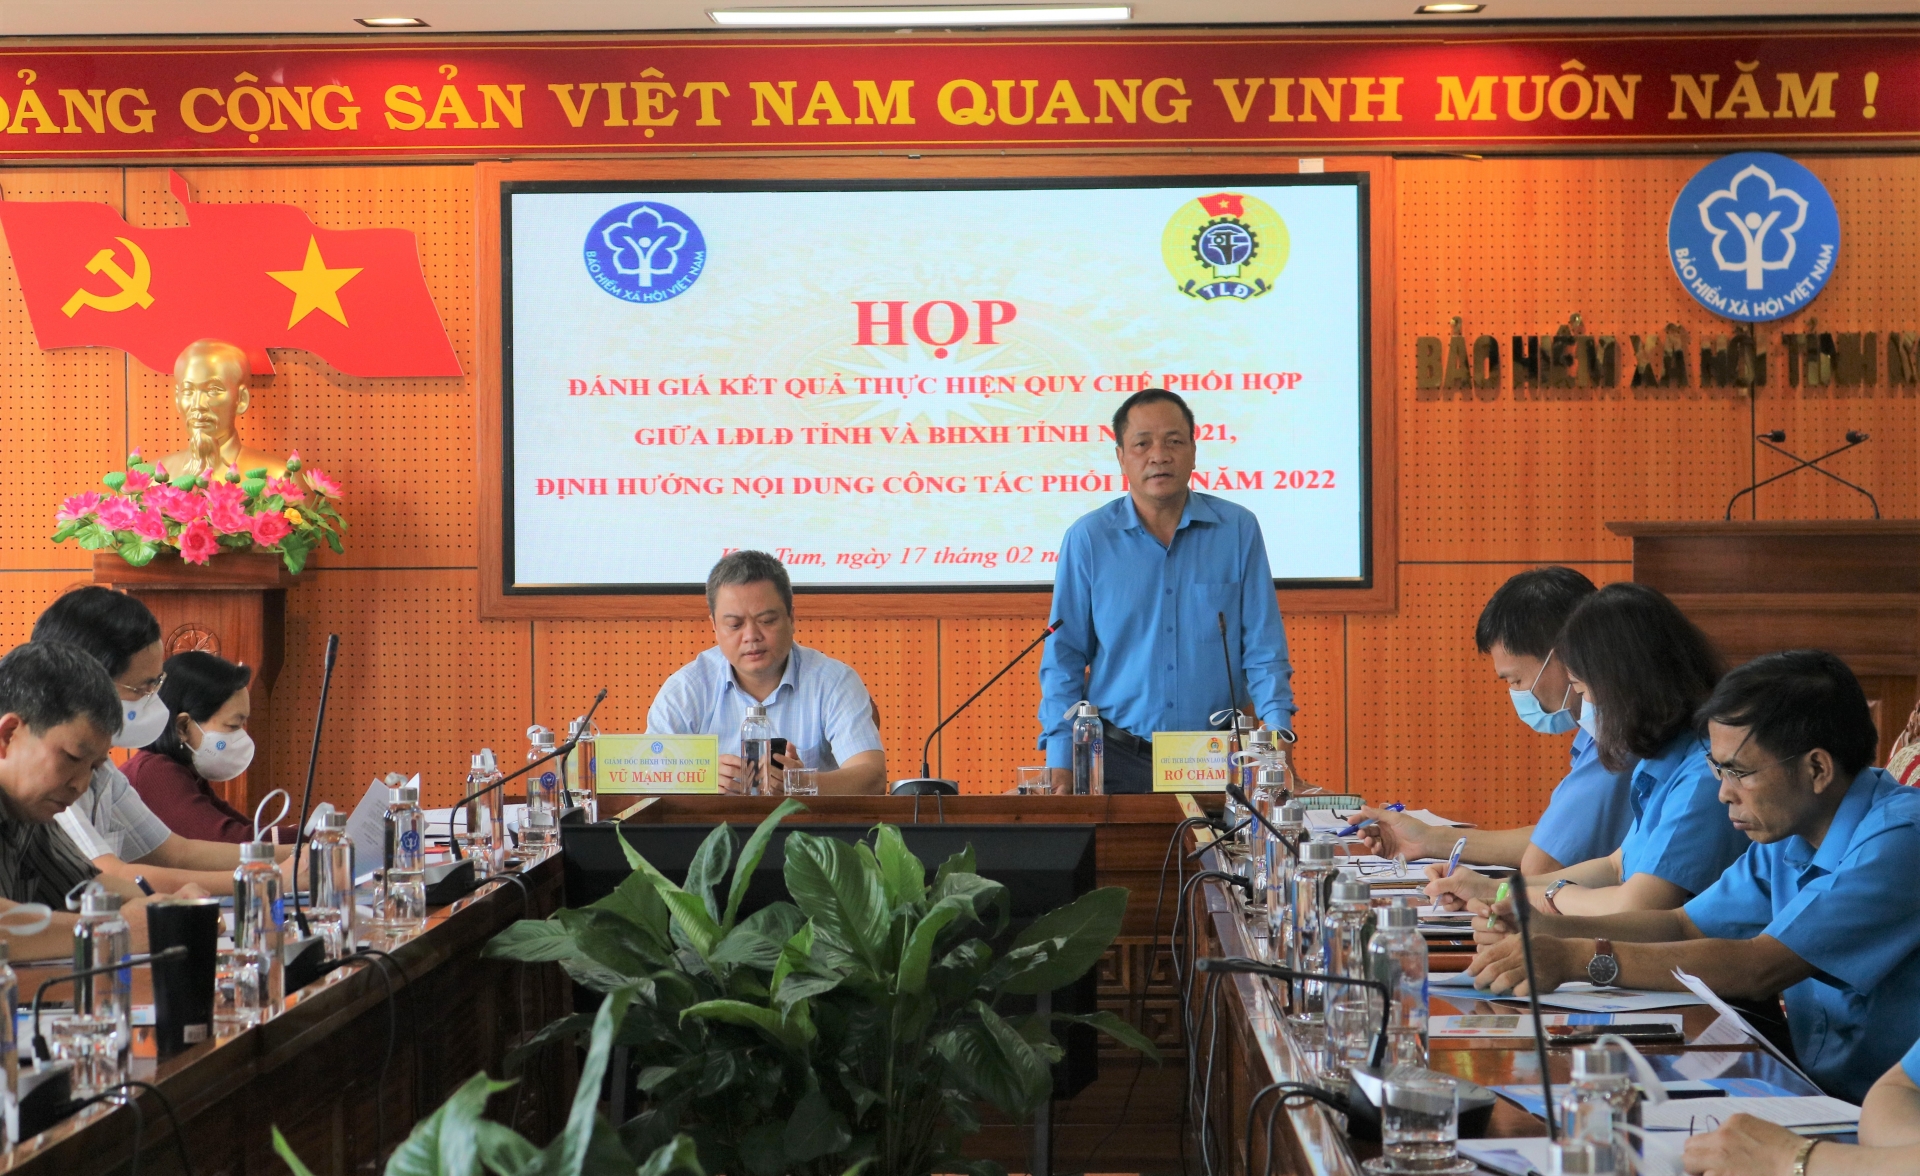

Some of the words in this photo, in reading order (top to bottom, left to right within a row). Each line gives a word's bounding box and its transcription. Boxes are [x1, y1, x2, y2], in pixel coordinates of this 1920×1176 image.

[0, 69, 156, 134] ẢNG
[180, 71, 360, 143] CỘNG
[383, 65, 526, 131] SẢN
[549, 68, 730, 138] VIỆT
[750, 80, 916, 126] NAM
[936, 78, 1192, 126] QUANG
[1214, 76, 1404, 124] VINH
[1435, 59, 1641, 122] MUÔN
[1669, 60, 1839, 119] NĂM
[688, 251, 705, 276] NAM
[1203, 283, 1249, 298] TLĐ
[1674, 247, 1698, 280] BẢO
[1691, 278, 1727, 310] HIỂM
[1728, 299, 1750, 316] XÃ
[1754, 297, 1784, 317] HỘI
[1783, 278, 1815, 306] VIỆT
[1810, 244, 1834, 281] NAM
[851, 300, 1017, 359] HỌP
[567, 374, 650, 396] ĐÁNH
[658, 374, 711, 396] GIÁ
[718, 374, 778, 396] KẾT
[784, 373, 848, 399] QUẢ
[854, 374, 937, 399] THỰC
[945, 374, 1016, 398] HIỆN
[1024, 376, 1087, 397] QUY
[1093, 371, 1153, 392] CHẾ
[1162, 370, 1234, 392] PHỐI
[1241, 371, 1303, 395] HỢP
[634, 424, 710, 446] GIỮA
[716, 427, 794, 445] LĐLĐ
[801, 422, 873, 445] TỈNH
[880, 422, 920, 444] VÀ
[928, 426, 1010, 444] BHXH
[1017, 421, 1090, 443] TỈNH
[535, 477, 607, 499] ĐỊNH
[616, 473, 724, 495] HƯỚNG
[732, 476, 784, 499] NỘI
[792, 476, 875, 495] DUNG
[882, 471, 967, 494] CÔNG
[973, 471, 1033, 493] TÁC
[1041, 470, 1113, 493] PHỐI
[1190, 466, 1264, 491] NĂM
[1274, 469, 1335, 490] 2022
[775, 547, 826, 567] Tum,
[836, 547, 891, 569] ngày
[900, 547, 927, 564] 17
[933, 546, 999, 568] tháng
[1006, 546, 1034, 563] 02
[640, 758, 659, 766] BHXH
[680, 758, 694, 766] KON
[696, 758, 711, 766] TUM
[1164, 768, 1183, 781] RƠ
[1187, 766, 1226, 781] CHĂM
[609, 768, 628, 783] VŨ
[632, 771, 673, 786] MẠNH
[677, 768, 707, 783] CHỮ
